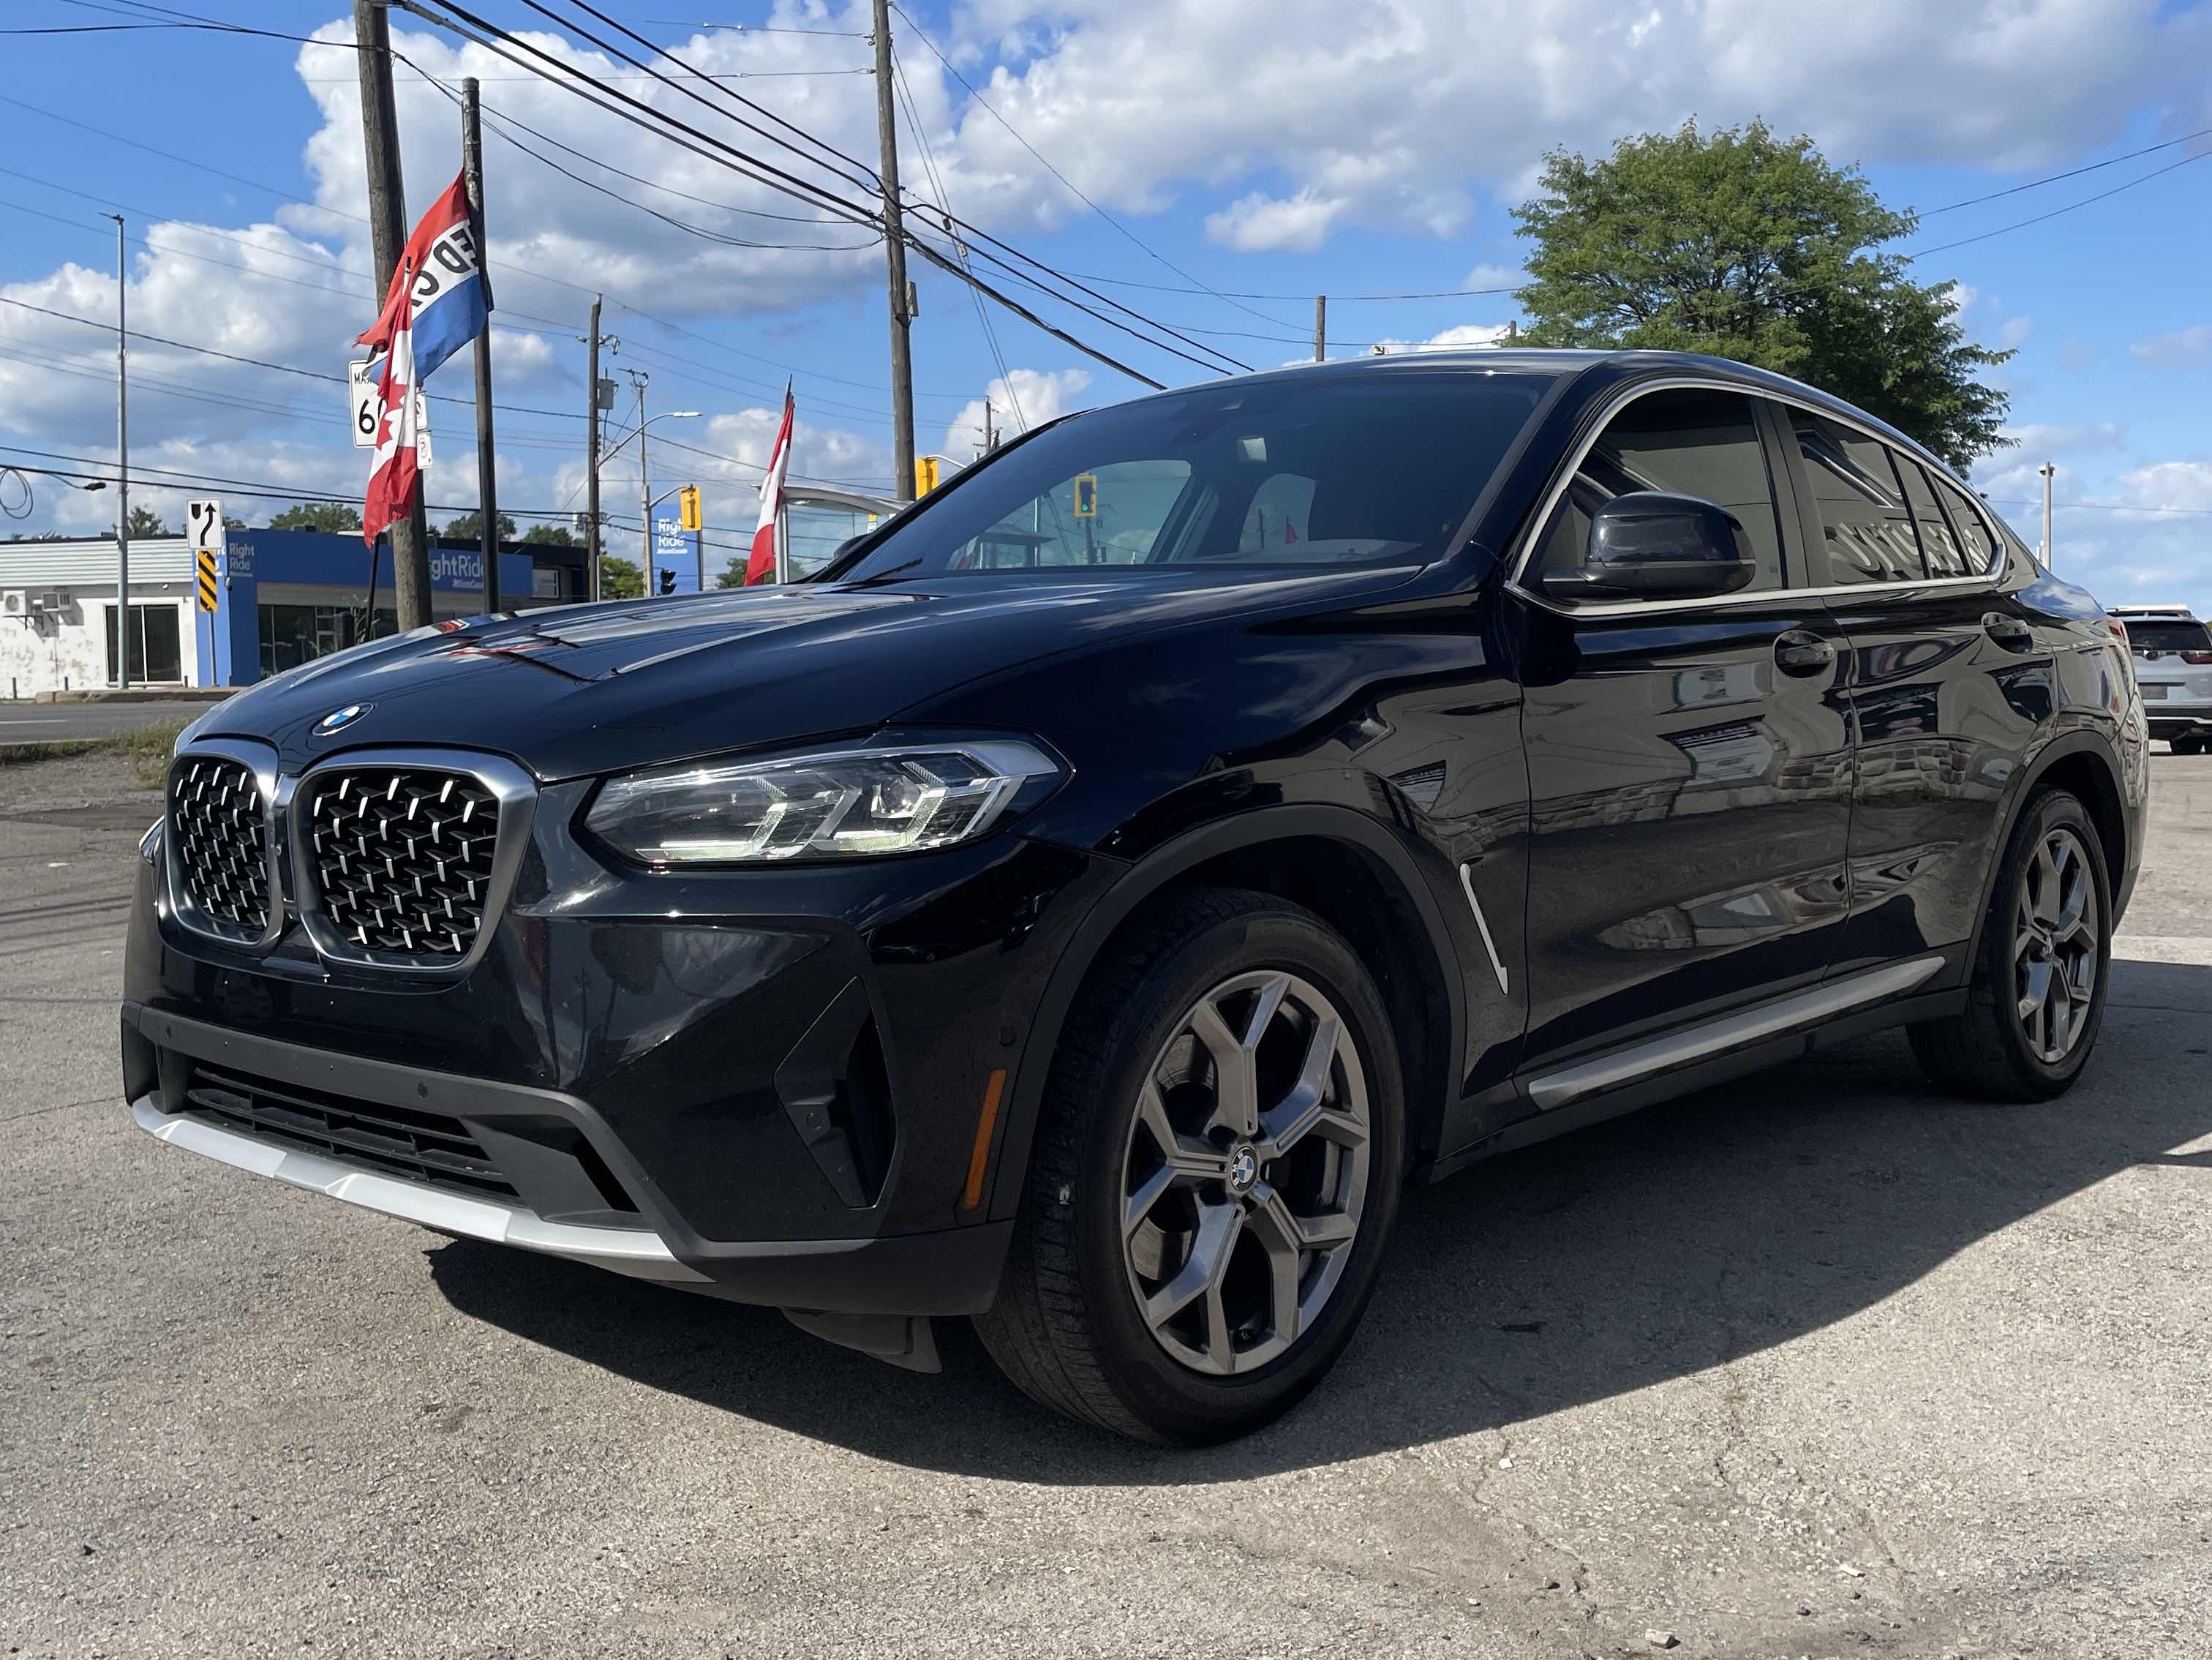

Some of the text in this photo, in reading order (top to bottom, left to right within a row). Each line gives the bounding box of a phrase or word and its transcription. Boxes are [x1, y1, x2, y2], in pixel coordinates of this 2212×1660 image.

[359, 399, 383, 435] 6
[228, 542, 255, 559] Right
[229, 557, 250, 570] Ride
